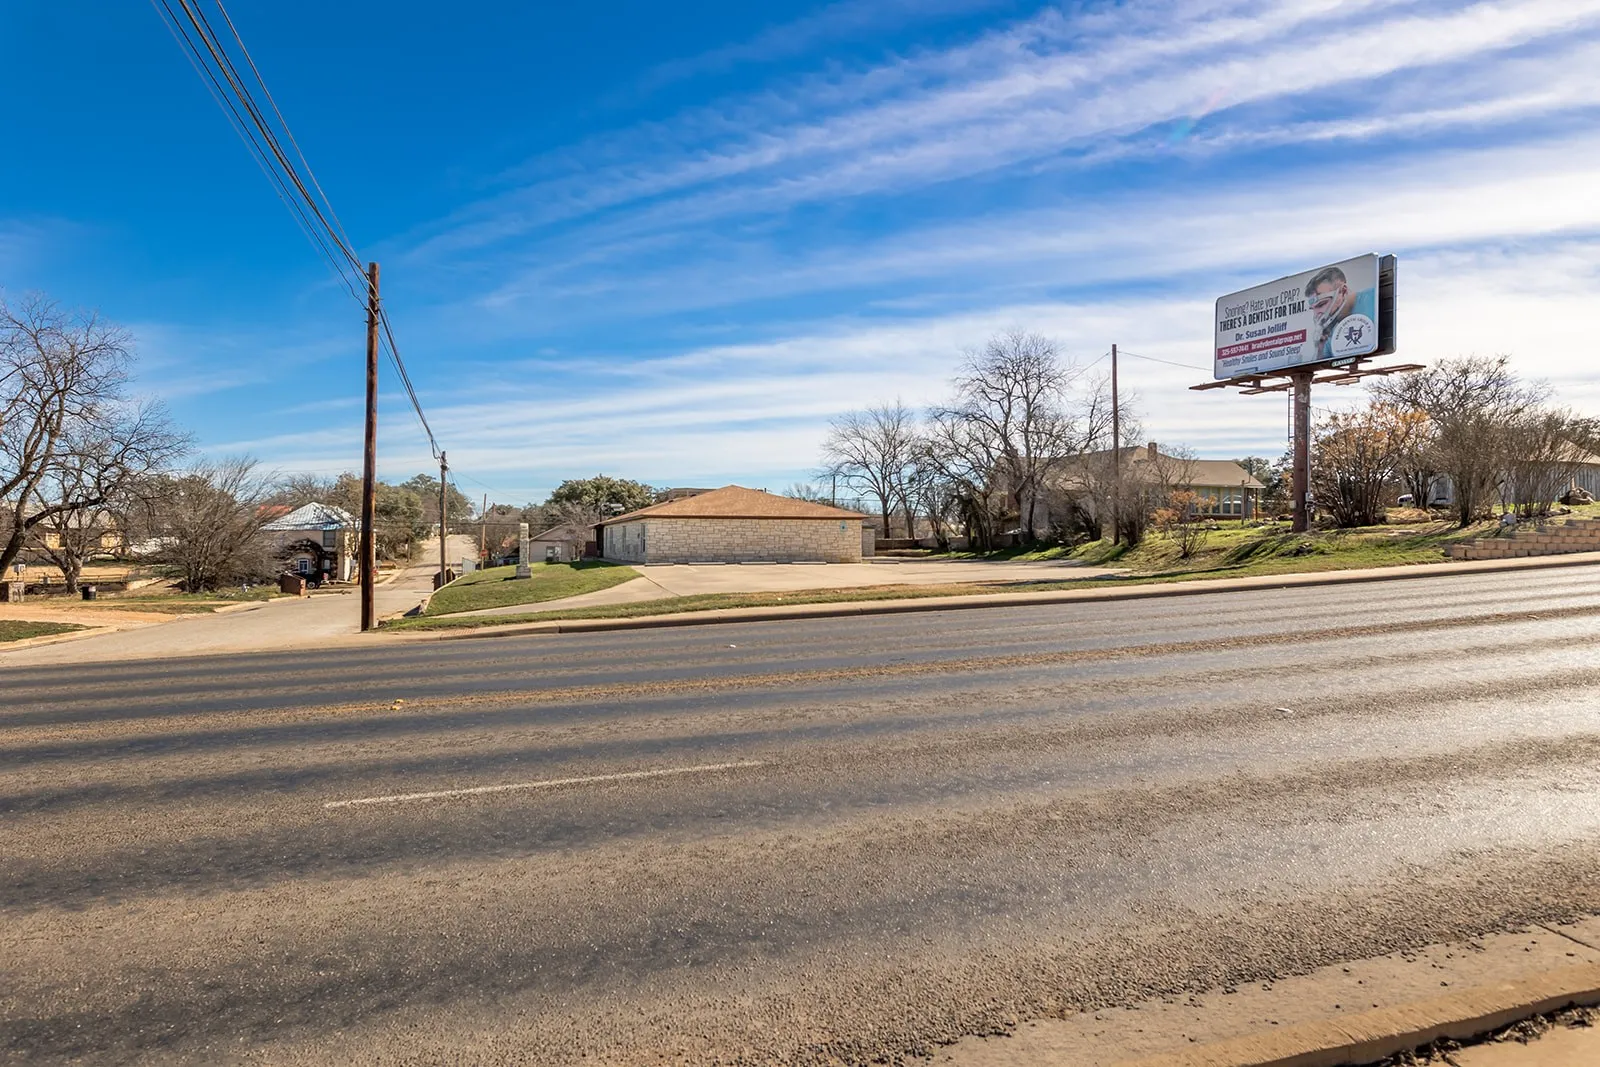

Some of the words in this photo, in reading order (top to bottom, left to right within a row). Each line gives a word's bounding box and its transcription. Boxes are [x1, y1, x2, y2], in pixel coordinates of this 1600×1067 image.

[1220, 317, 1241, 332] THERE'S
[1243, 316, 1247, 326] A
[1249, 310, 1272, 325] DENTIST
[1275, 307, 1287, 318] FOR
[1289, 300, 1307, 315] THAT.
[1225, 302, 1249, 319] Snoring?
[1250, 300, 1264, 311] Hate
[1265, 296, 1279, 309] your
[1280, 288, 1300, 305] CPAP?
[1235, 333, 1244, 341] Dr.
[1246, 328, 1266, 339] Susan
[1267, 322, 1287, 334] Jolliff
[1242, 354, 1257, 364] Smiles
[1258, 350, 1269, 360] and
[1269, 348, 1285, 359] Sound
